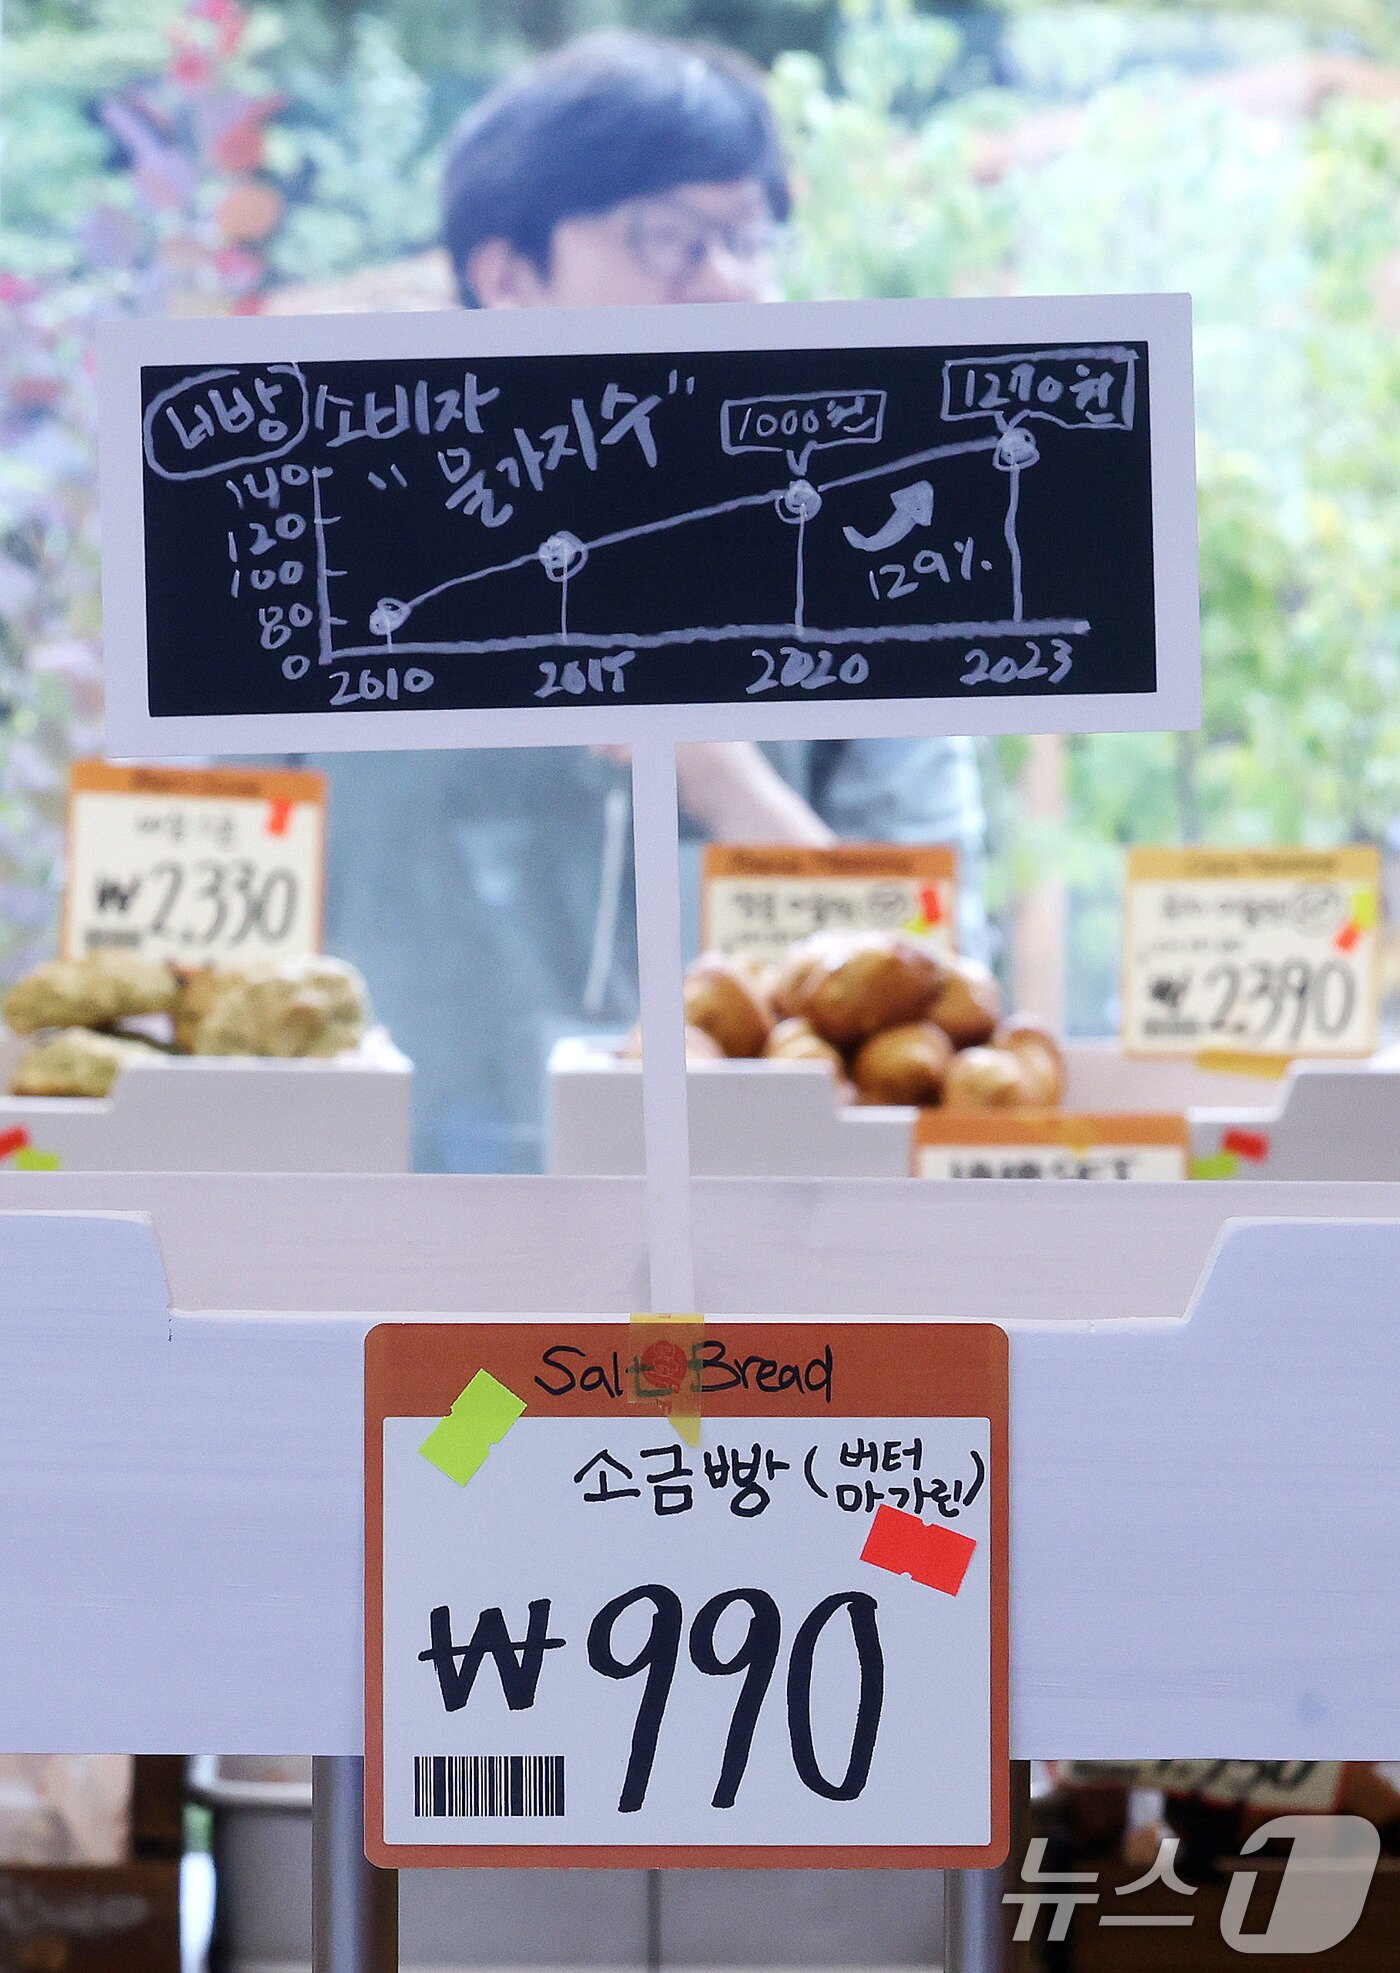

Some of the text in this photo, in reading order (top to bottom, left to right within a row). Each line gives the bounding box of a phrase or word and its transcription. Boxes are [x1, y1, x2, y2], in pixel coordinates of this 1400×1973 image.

[315, 372, 499, 448] 소비자
[739, 396, 875, 441] 1000원
[226, 463, 310, 510] 140
[228, 513, 307, 563] 120
[231, 560, 305, 598] 100
[868, 536, 993, 601] 129%
[257, 603, 313, 650] 80
[280, 654, 311, 681] 0
[329, 666, 434, 706] 2010
[746, 646, 869, 695] 2020
[960, 639, 1073, 686] 2023
[534, 1340, 834, 1404] Salt Bread
[573, 1443, 791, 1517] 소금빵
